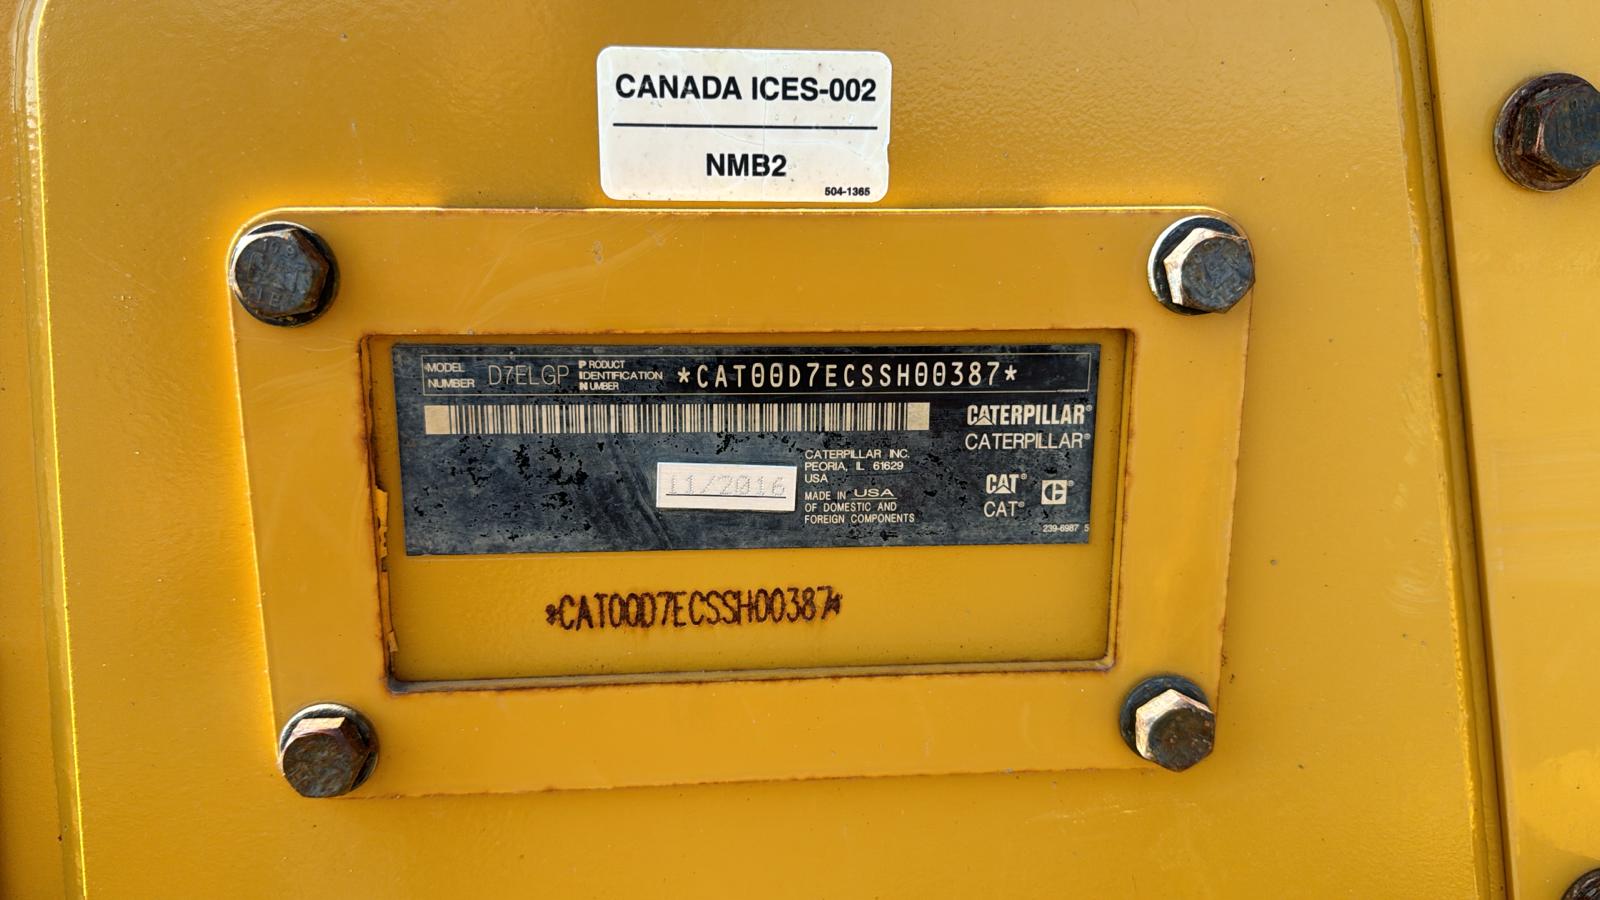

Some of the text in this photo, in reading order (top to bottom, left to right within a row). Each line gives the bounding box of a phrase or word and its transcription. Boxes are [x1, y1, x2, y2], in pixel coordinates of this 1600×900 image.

[615, 74, 876, 101] CANADA ICES-002
[706, 153, 787, 177] NMB2
[824, 187, 871, 197] 504-1365
[426, 362, 465, 373] MODEL
[488, 364, 570, 386] D7ELGP
[578, 371, 663, 380] IDENTIFICATION
[427, 378, 475, 389] NUMBER
[804, 448, 911, 460] CATERPILLAR INC.
[804, 461, 904, 472] PEORIA, IL 61629
[804, 474, 828, 483] USA
[668, 474, 785, 496] 11/2016
[804, 488, 894, 501] MADE IN USA
[804, 502, 897, 513] OF DOMESTIC AND
[804, 513, 915, 524] FOREIGN COMPONENTS
[1042, 524, 1079, 533] 239-6987
